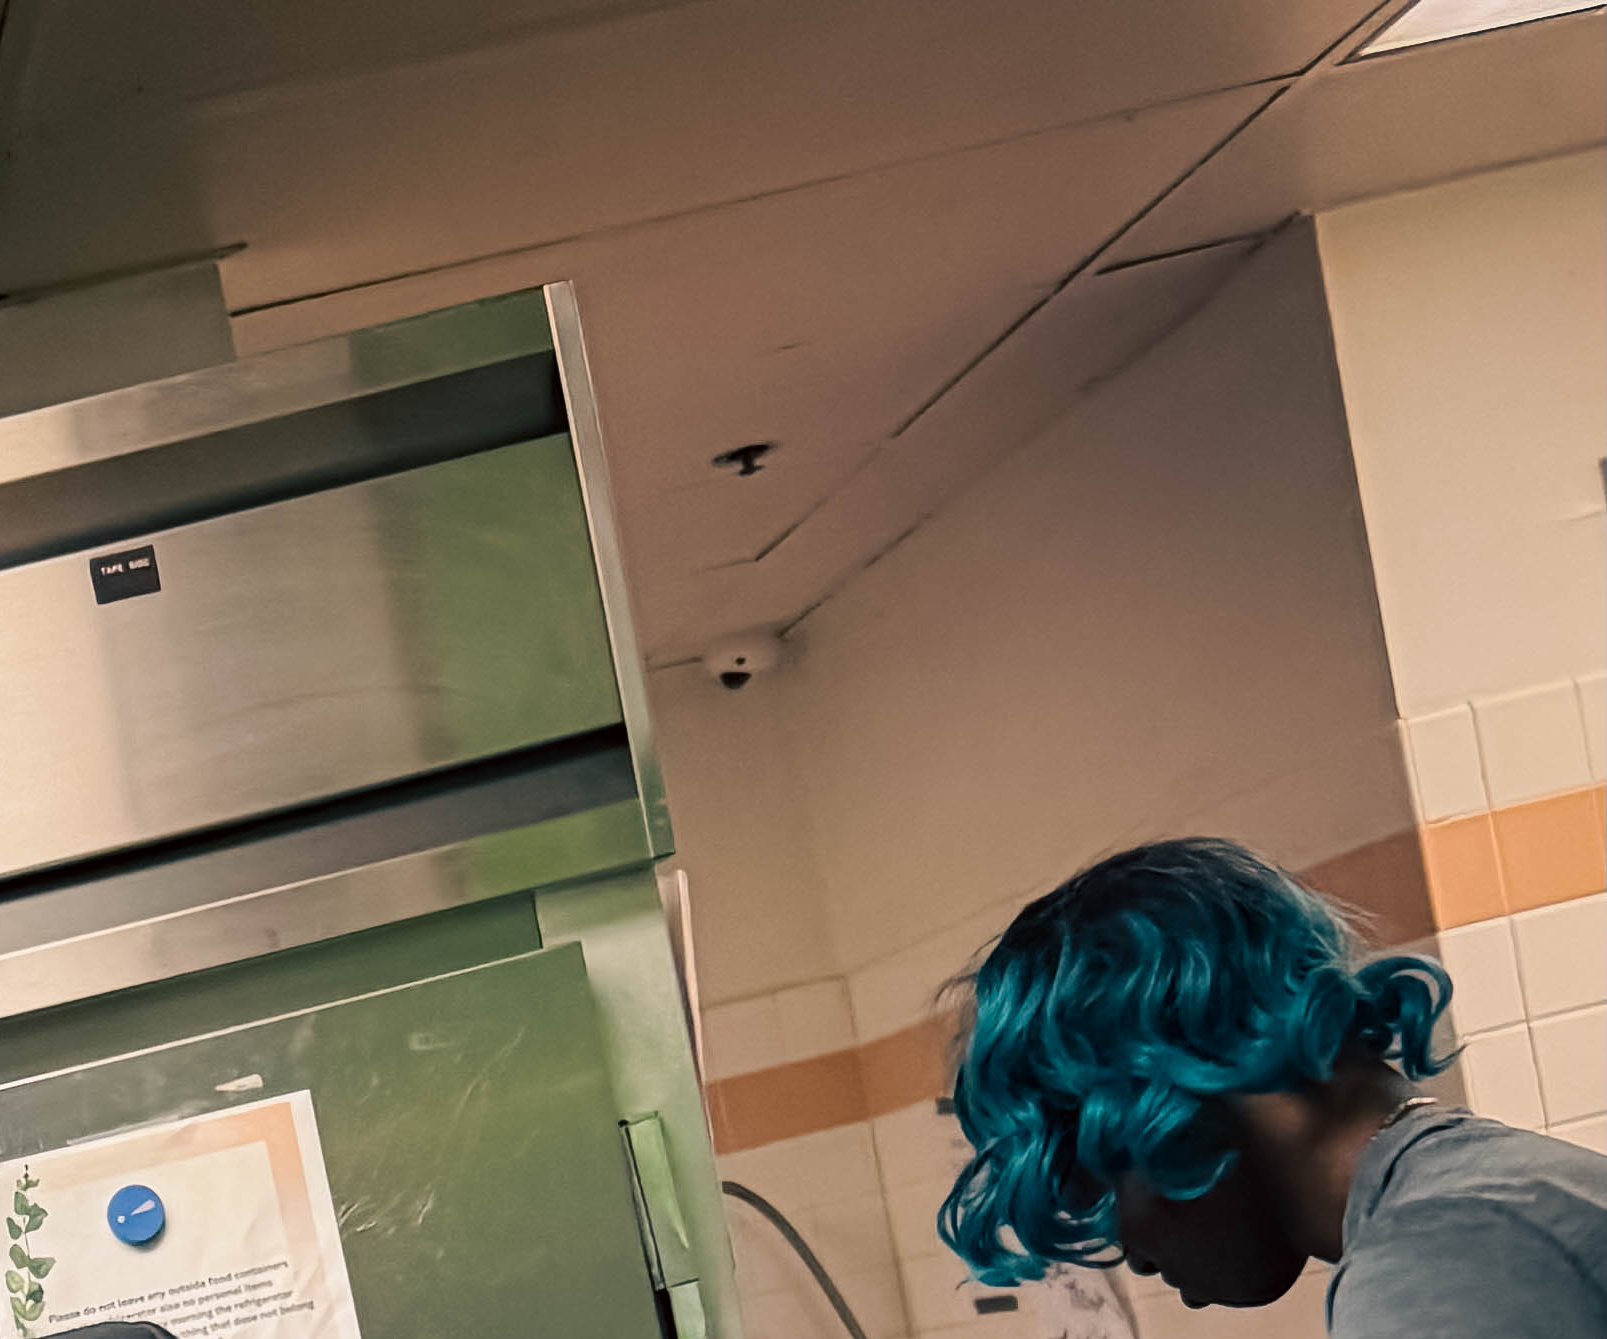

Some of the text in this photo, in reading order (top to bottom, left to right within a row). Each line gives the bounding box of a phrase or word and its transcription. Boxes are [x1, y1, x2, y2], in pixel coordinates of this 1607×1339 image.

[82, 1304, 96, 1315] do
[118, 1295, 144, 1306] leave
[168, 1280, 205, 1295] outside
[207, 1272, 232, 1285] food
